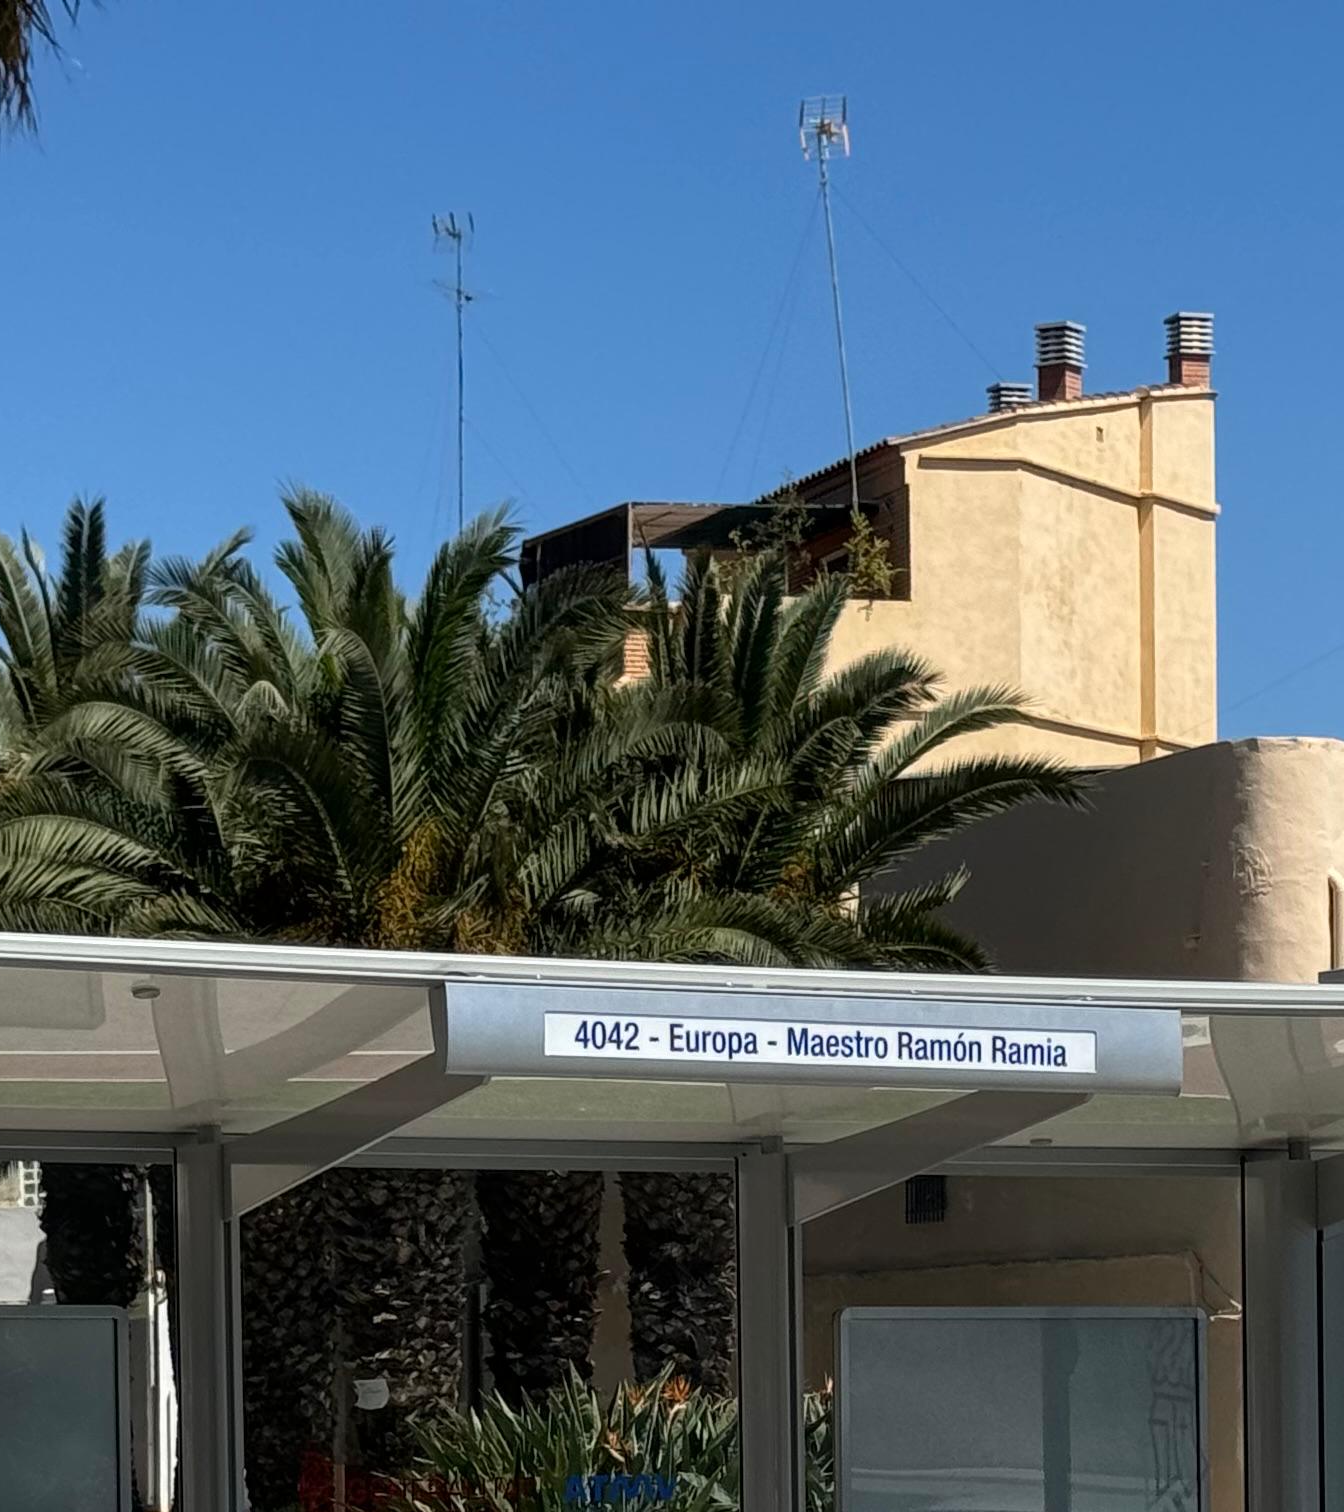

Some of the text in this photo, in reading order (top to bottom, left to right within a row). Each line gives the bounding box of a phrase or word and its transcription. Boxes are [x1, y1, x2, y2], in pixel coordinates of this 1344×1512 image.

[574, 1019, 640, 1052] 4042
[669, 1023, 758, 1056] Europa
[787, 1027, 889, 1060] Maestro
[897, 1032, 983, 1065] Ramón
[991, 1037, 1068, 1068] Ramia
